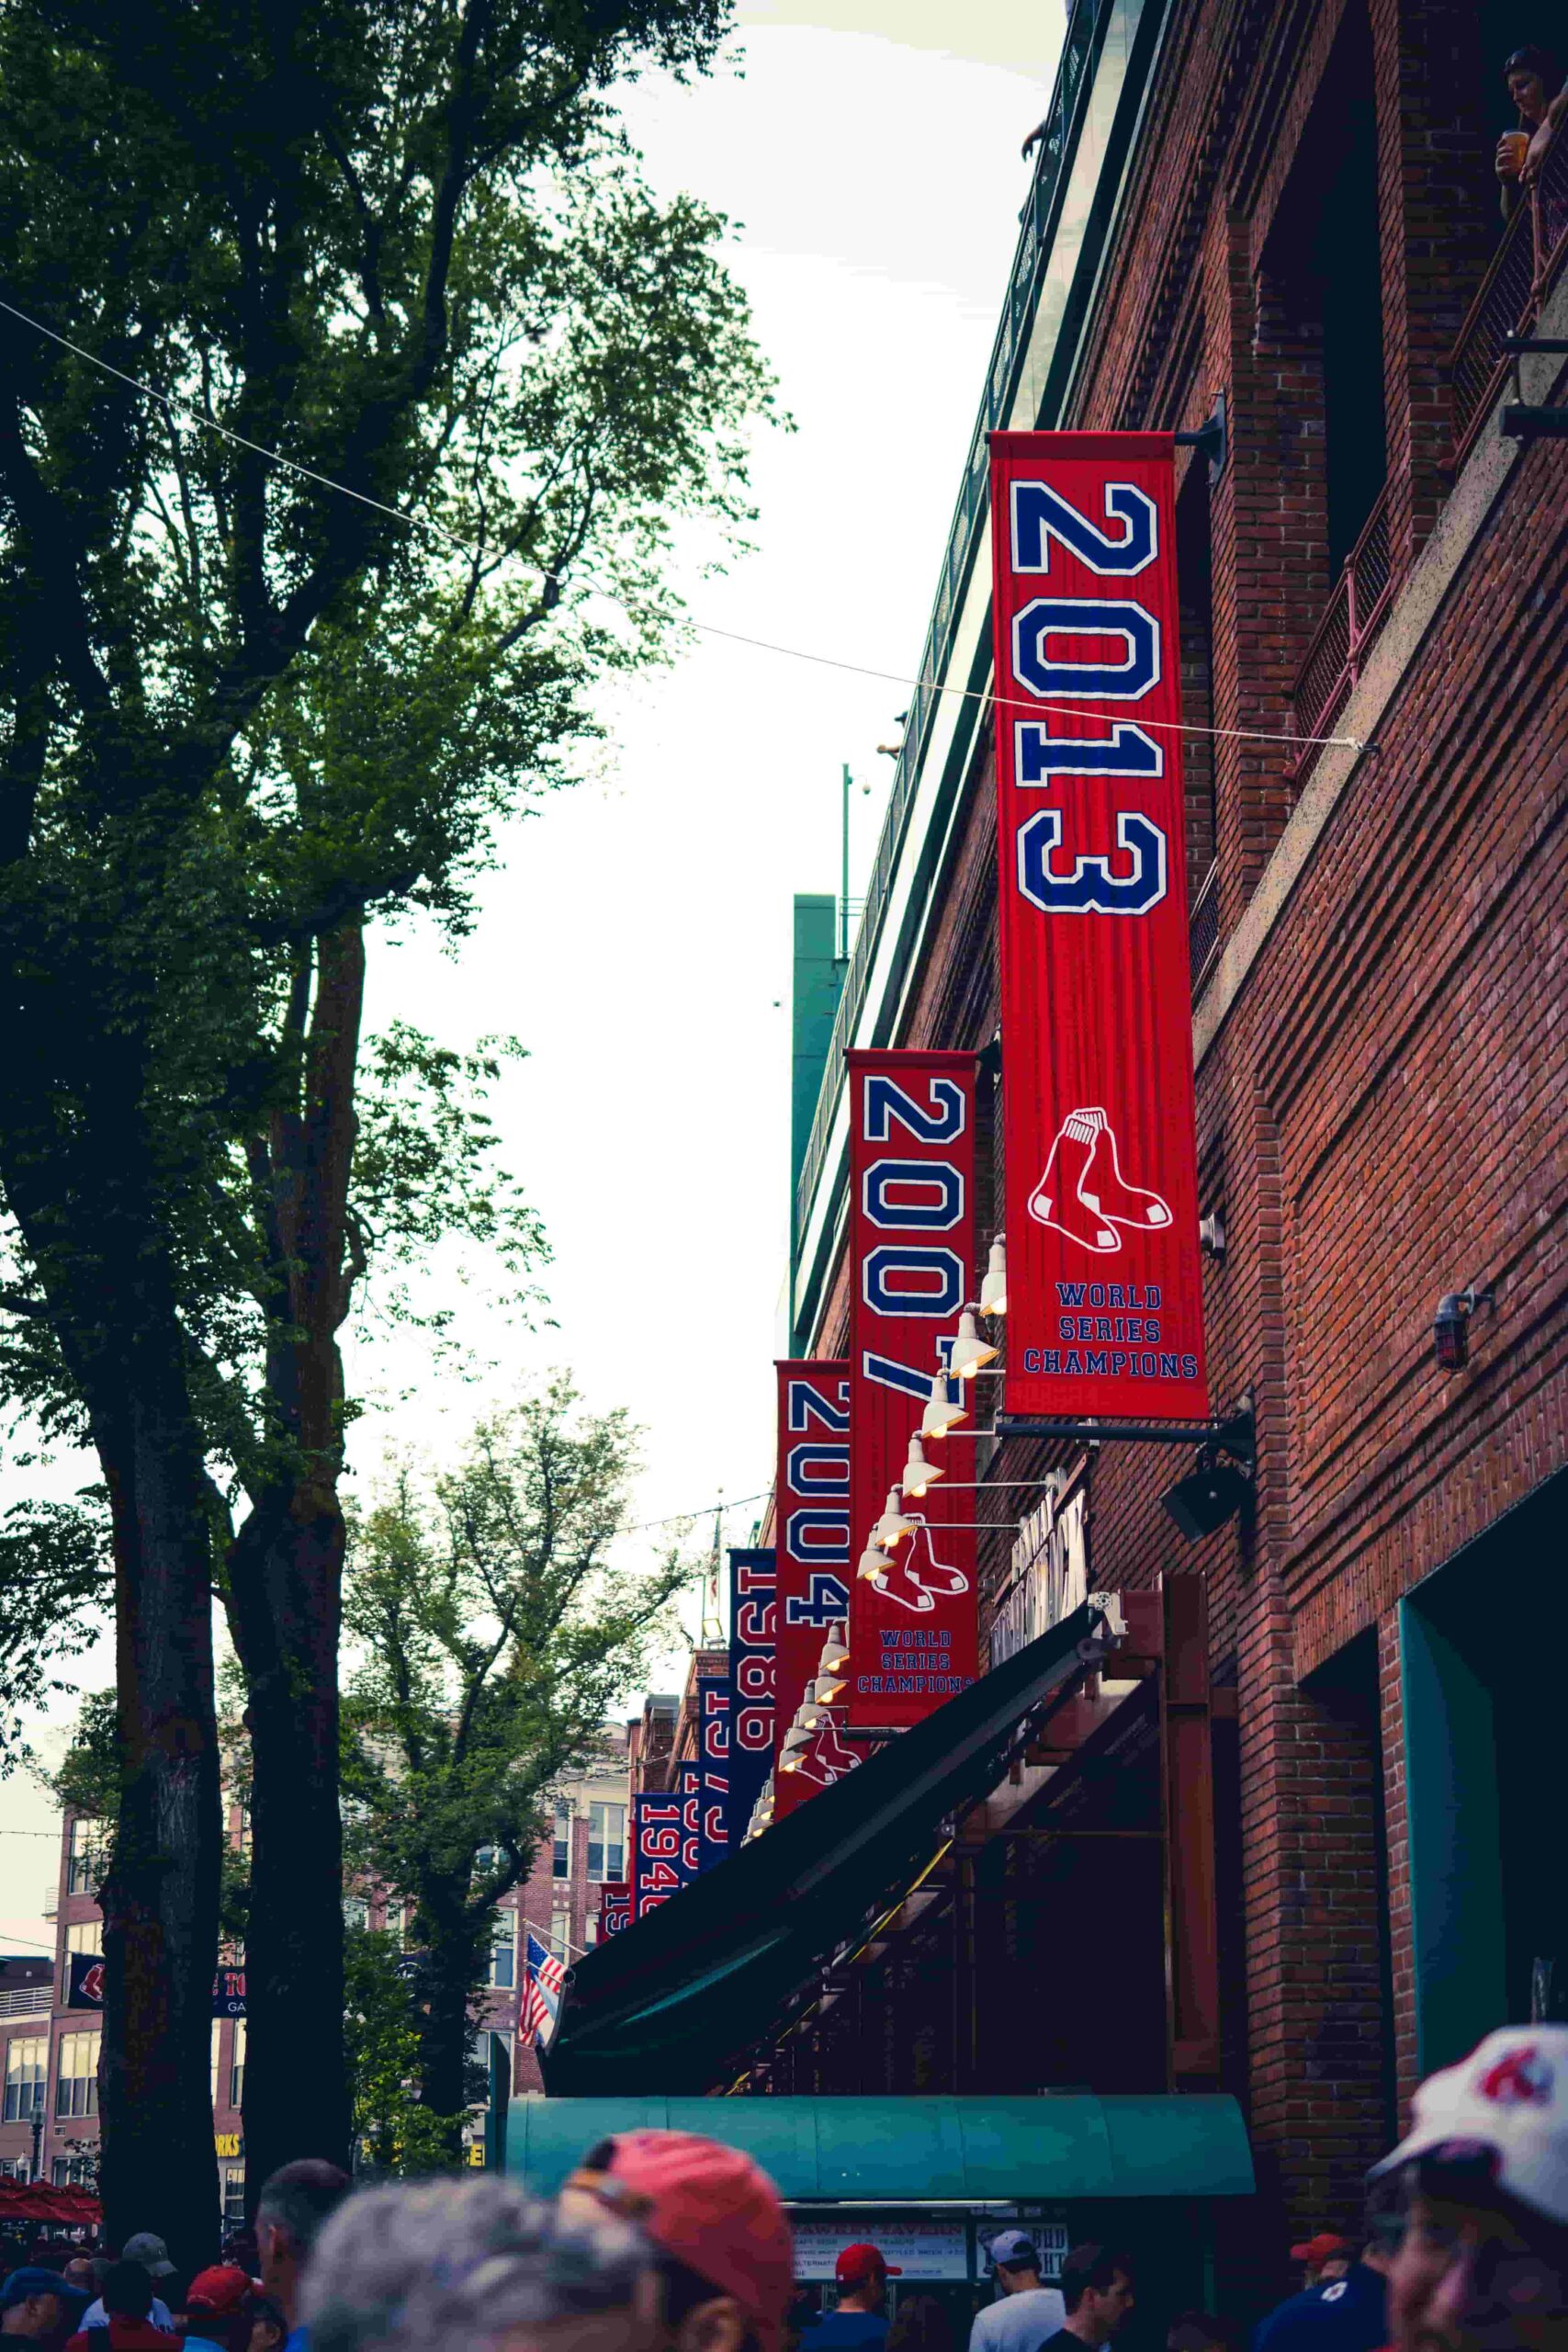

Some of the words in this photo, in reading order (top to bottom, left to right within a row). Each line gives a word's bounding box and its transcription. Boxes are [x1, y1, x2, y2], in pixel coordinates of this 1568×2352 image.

[1010, 480, 1168, 916] 2013
[863, 1074, 965, 1409] 2007
[1055, 1283, 1162, 1309] WORLD
[1059, 1317, 1161, 1343] SERIES
[1023, 1349, 1198, 1379] CHAMPIONS
[786, 1381, 850, 1628] 2004
[879, 1630, 952, 1647] WORLD
[881, 1653, 951, 1670] SERIES
